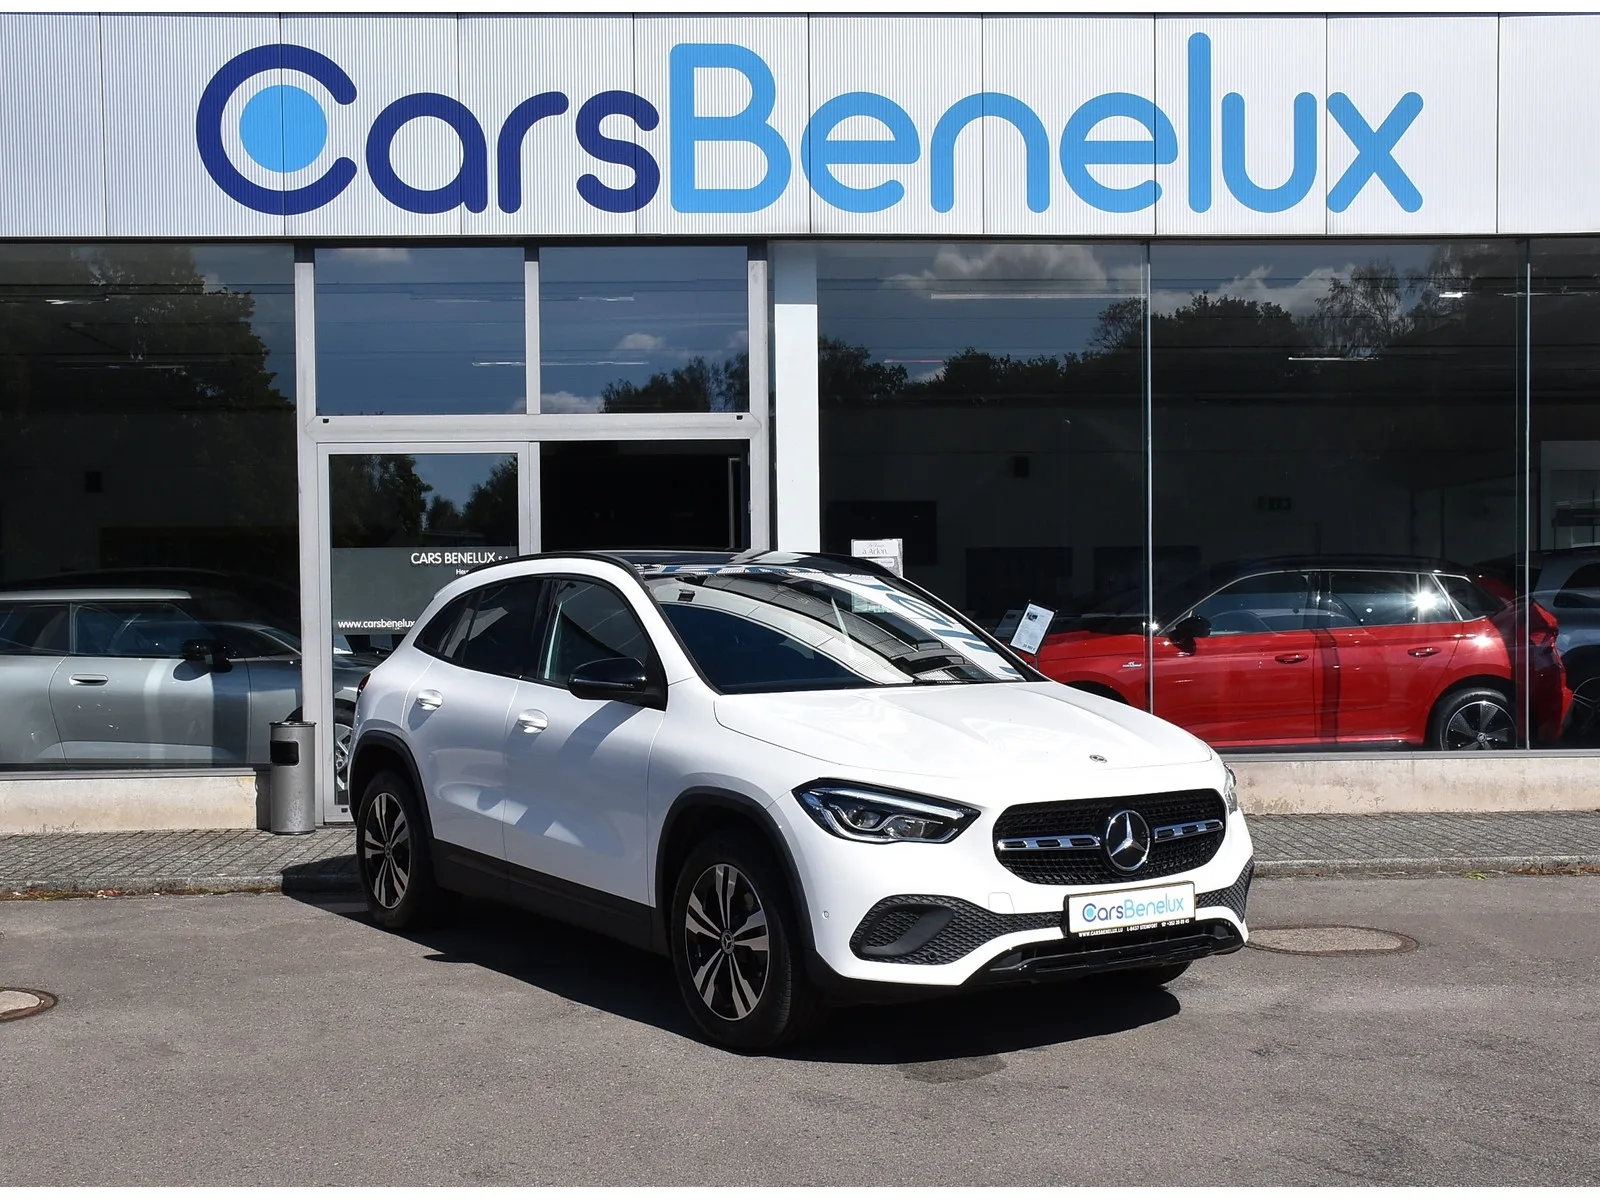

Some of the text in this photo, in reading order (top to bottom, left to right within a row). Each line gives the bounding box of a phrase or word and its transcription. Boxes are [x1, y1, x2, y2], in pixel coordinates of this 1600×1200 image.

[196, 32, 1424, 214] CarsBenelux
[410, 552, 442, 564] CARS
[444, 552, 496, 564] BENELUX
[1082, 893, 1184, 922] CarsBenelux
